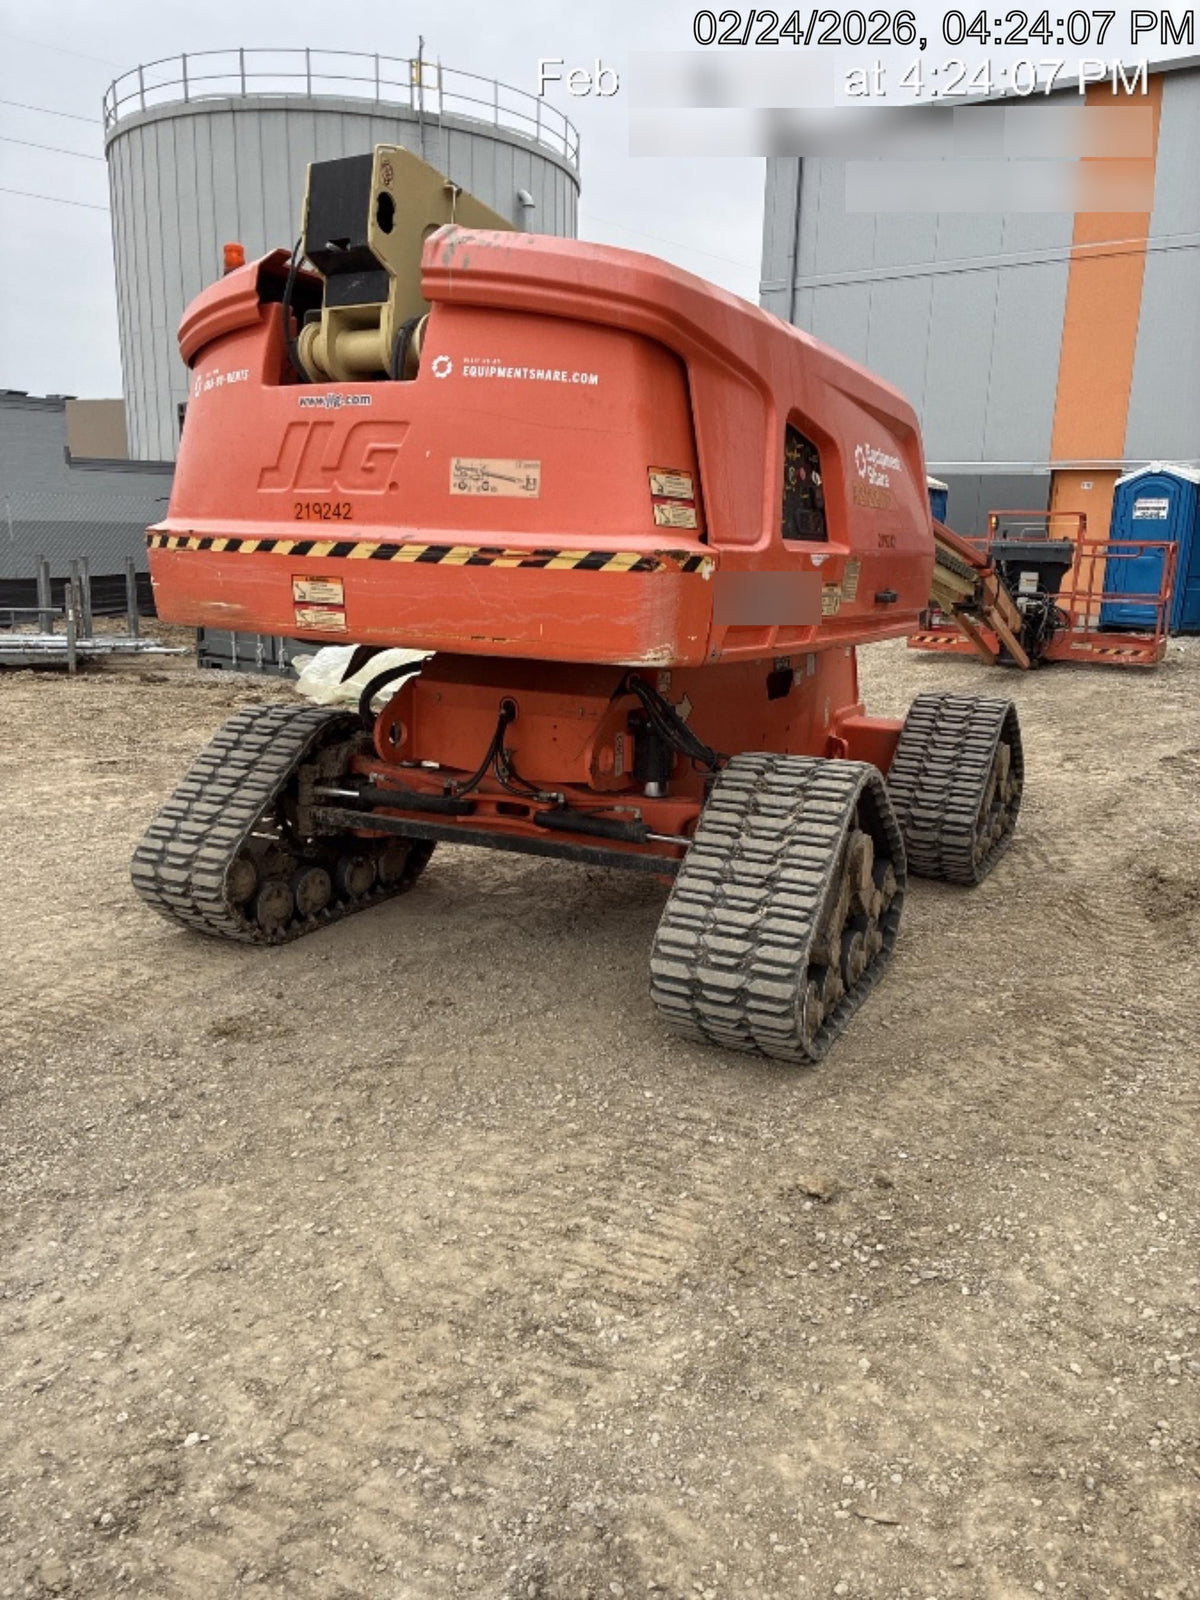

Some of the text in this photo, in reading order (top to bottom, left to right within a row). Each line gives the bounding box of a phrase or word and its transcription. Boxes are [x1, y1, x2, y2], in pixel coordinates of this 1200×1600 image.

[462, 365, 599, 386] EQUIPMENTSHARE.COM
[298, 393, 371, 408] www.jlg.com
[295, 502, 352, 520] 219242
